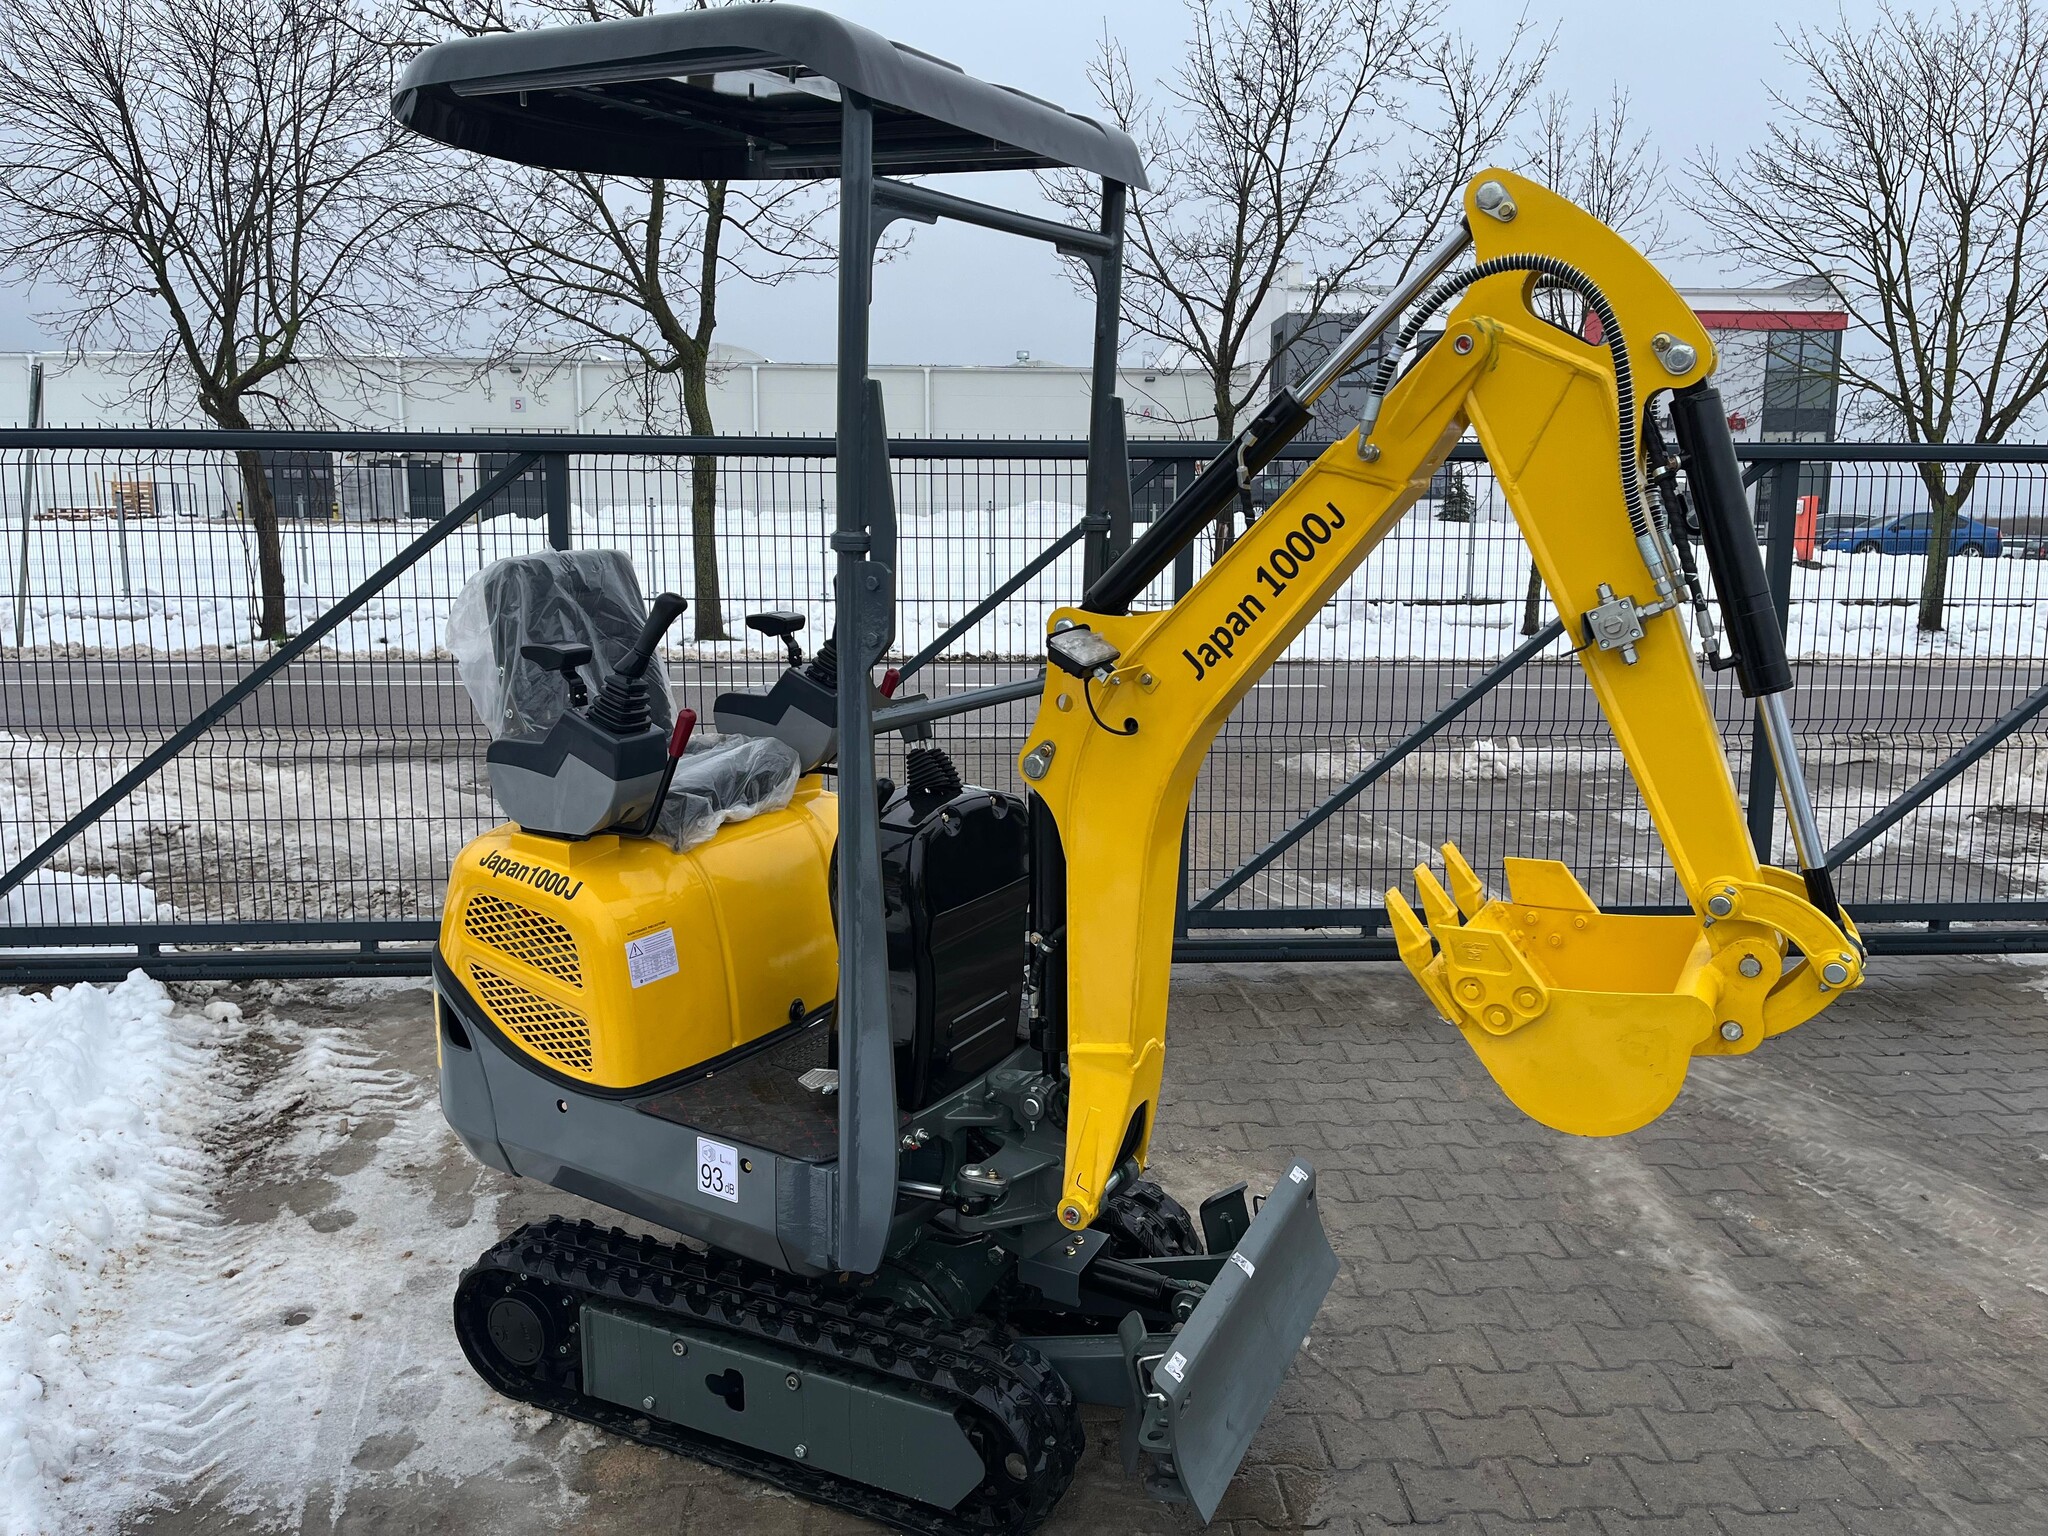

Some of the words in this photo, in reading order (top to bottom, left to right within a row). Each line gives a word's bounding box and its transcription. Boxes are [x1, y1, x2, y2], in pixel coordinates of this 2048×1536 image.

[515, 400, 521, 409] 5
[1182, 594, 1266, 681] Japan
[1257, 502, 1345, 598] 1000J
[479, 850, 583, 900] Japan1000J
[701, 1163, 724, 1192] 93
[725, 1183, 734, 1195] dB
